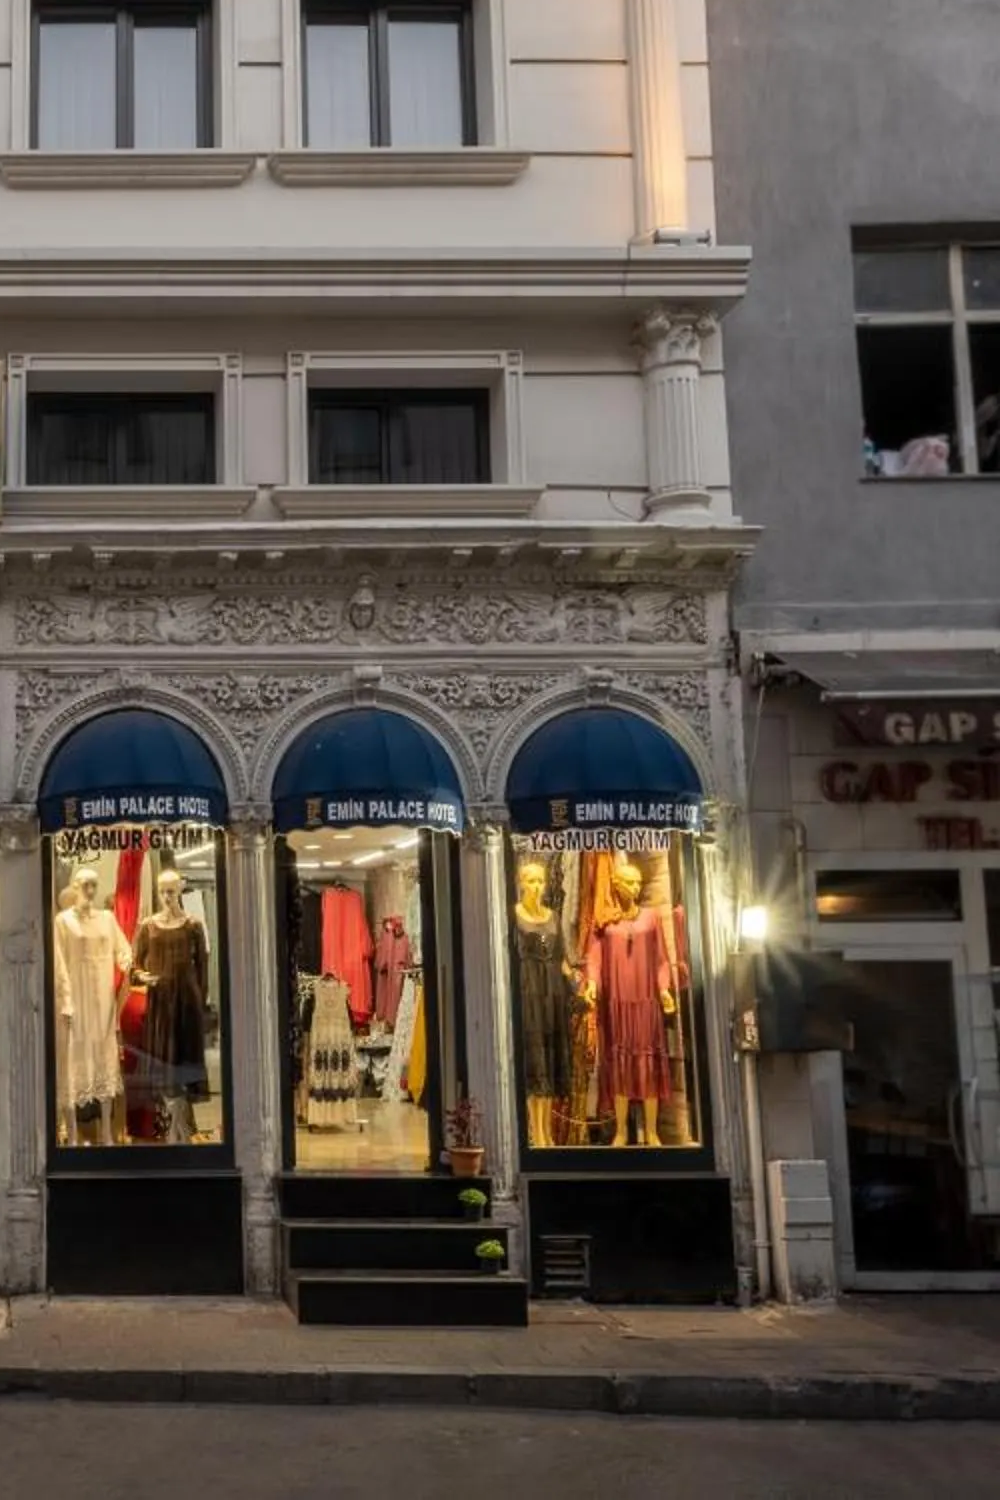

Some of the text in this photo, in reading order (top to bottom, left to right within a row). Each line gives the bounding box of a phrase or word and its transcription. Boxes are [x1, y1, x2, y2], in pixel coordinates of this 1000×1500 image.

[884, 711, 978, 744] GAP
[821, 760, 933, 803] GAP
[82, 795, 116, 819] EMİN
[119, 795, 175, 815] PALACE
[369, 800, 424, 819] PALACE
[427, 802, 457, 823] HOTEL
[619, 802, 673, 821] PALACE
